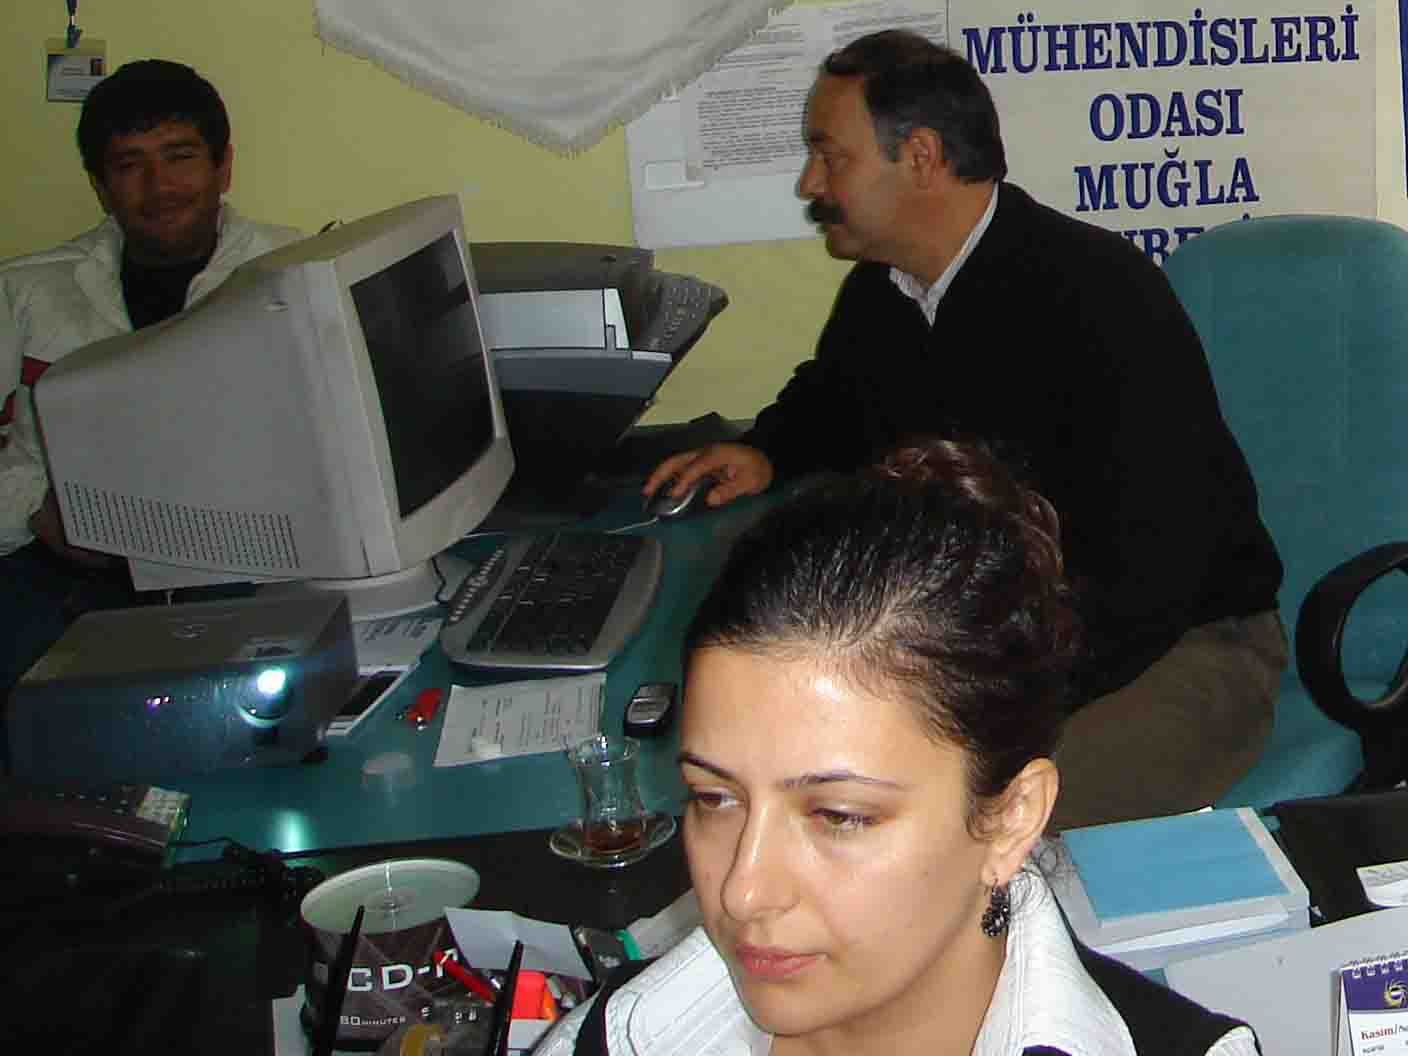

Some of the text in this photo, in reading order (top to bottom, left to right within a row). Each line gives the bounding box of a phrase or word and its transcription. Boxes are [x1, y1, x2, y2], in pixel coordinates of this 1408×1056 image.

[962, 4, 1360, 75] MÜHENDİSLERİ
[1089, 88, 1245, 141] ODASI
[1074, 146, 1260, 212] MUĞLA
